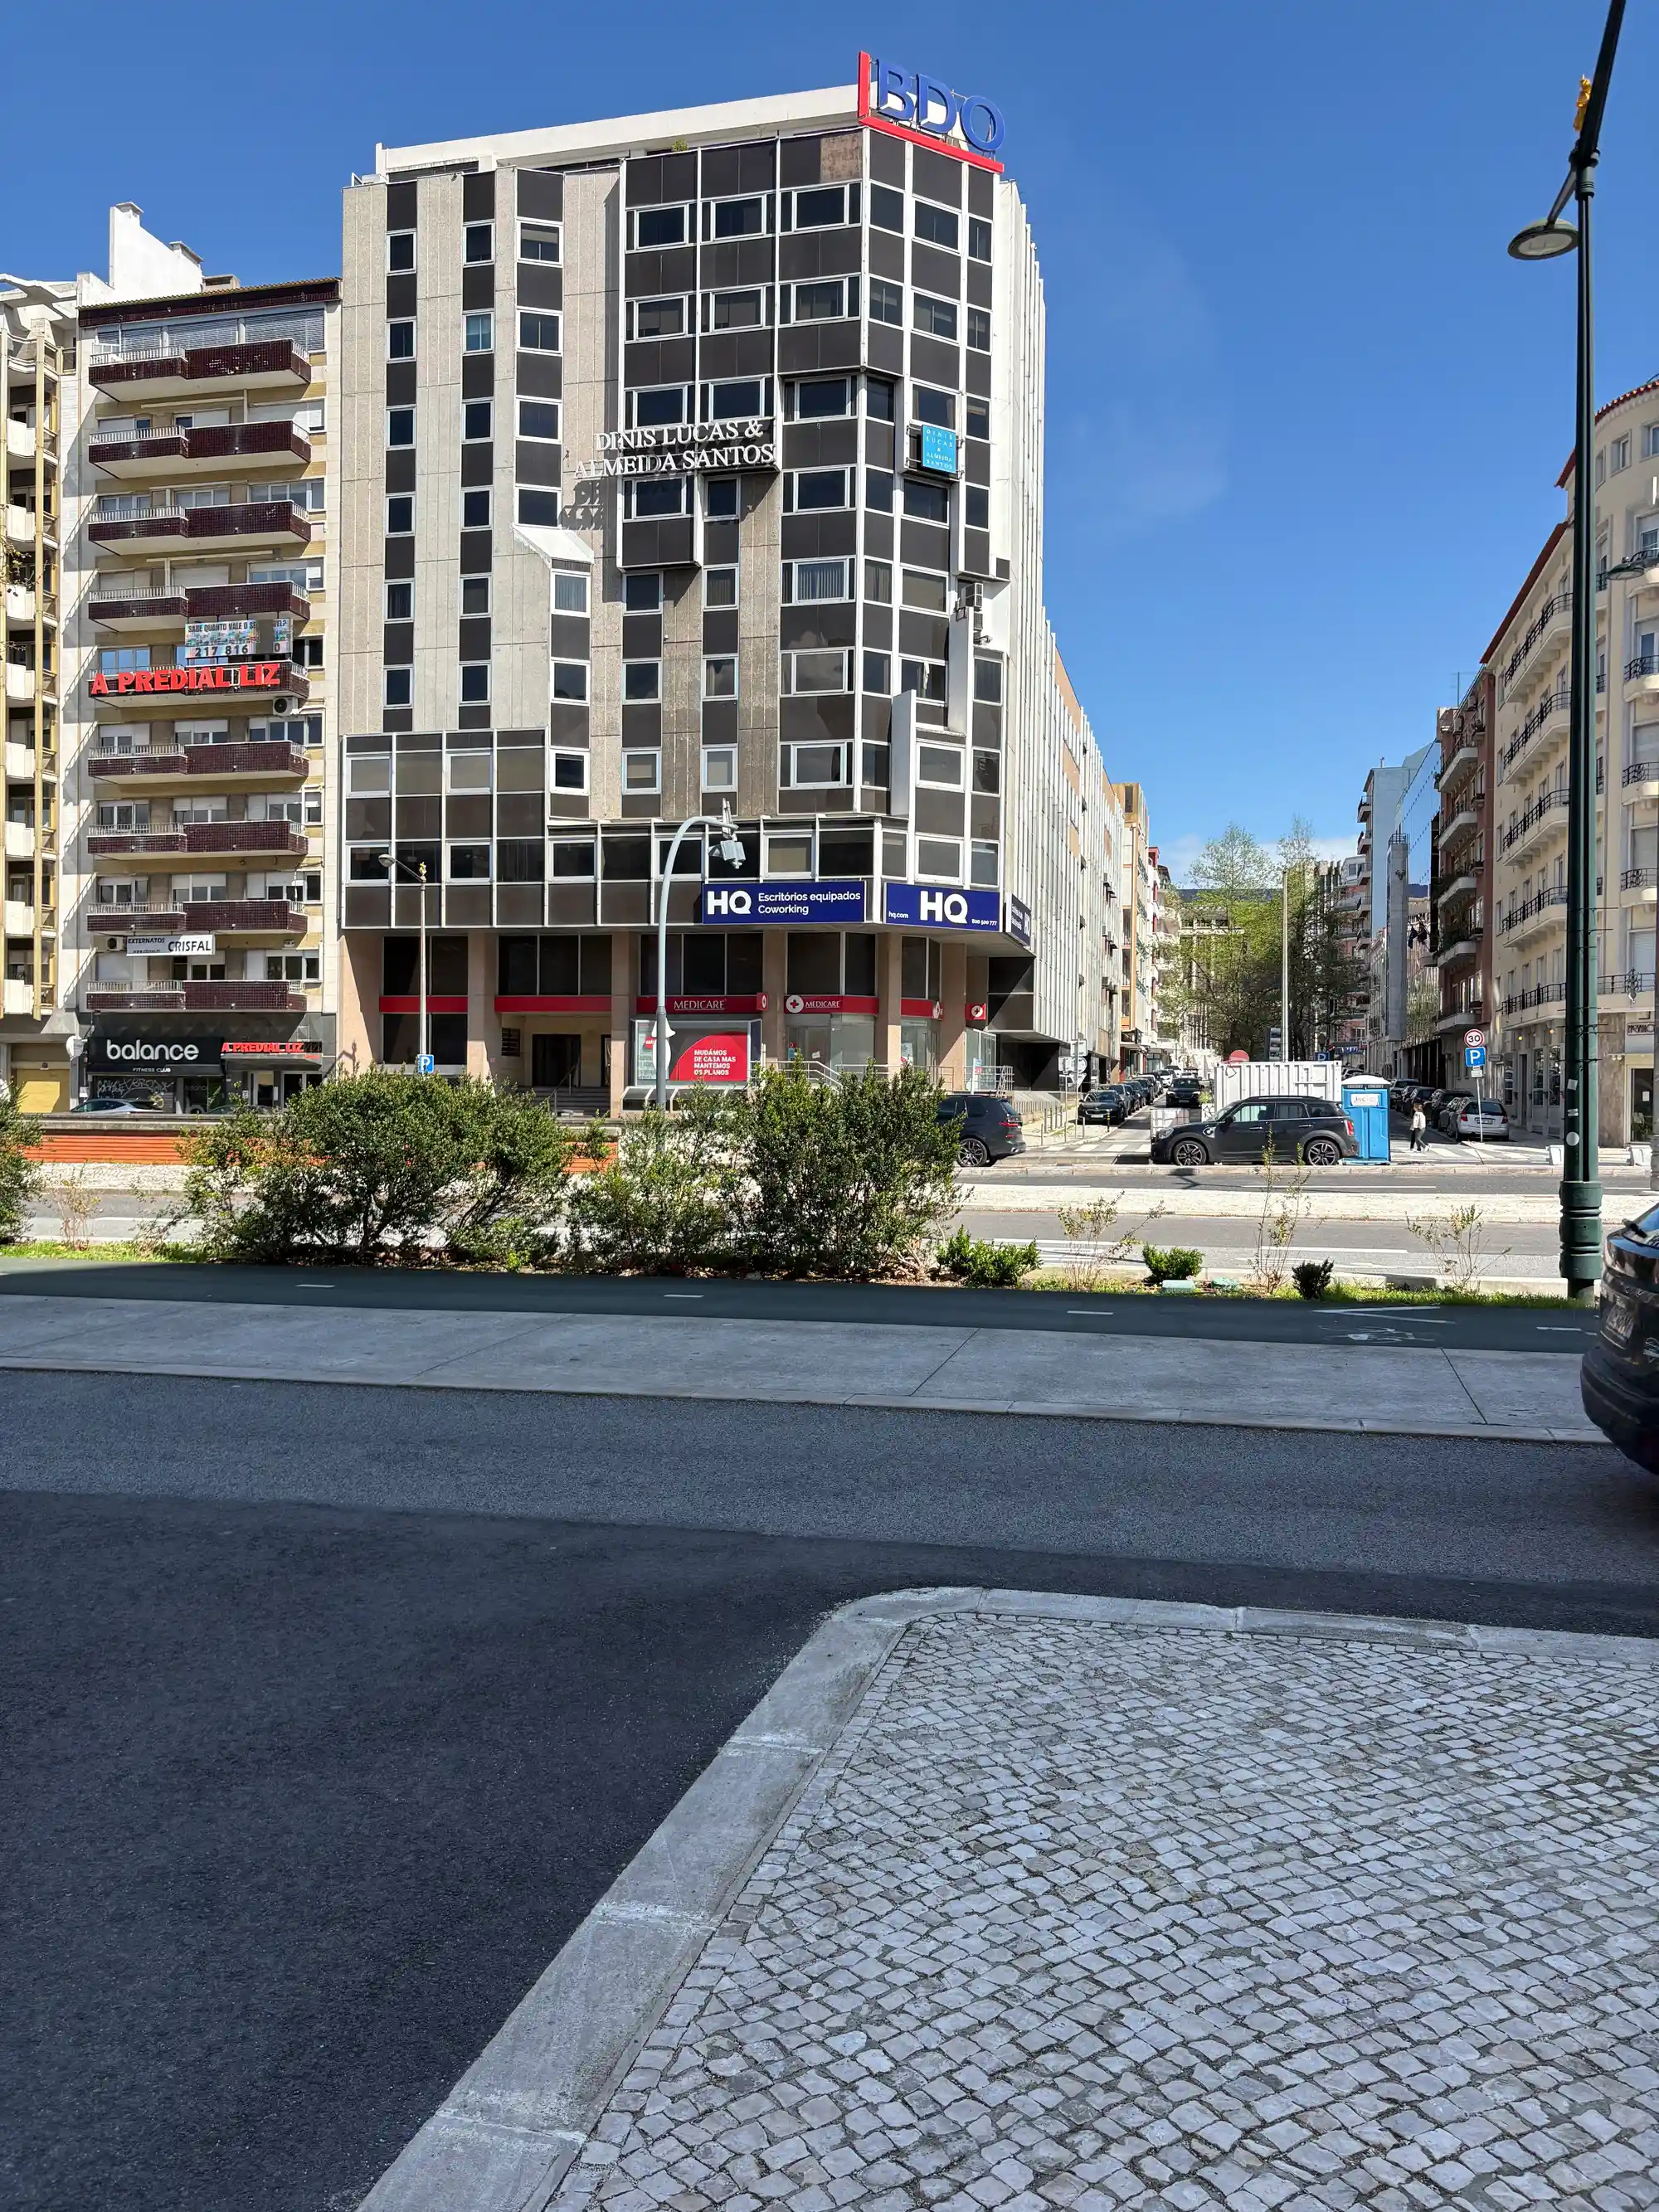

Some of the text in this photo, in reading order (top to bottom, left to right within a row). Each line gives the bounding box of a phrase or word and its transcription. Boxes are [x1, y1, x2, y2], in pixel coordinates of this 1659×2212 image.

[876, 59, 1005, 152] BDO
[595, 418, 764, 452] DINIS LUCAS &
[572, 443, 776, 479] ALMEIDA SANTOS
[188, 624, 202, 633] SABE
[204, 622, 227, 633] QUANTO
[228, 621, 242, 630] VALE
[195, 647, 218, 657] 217
[225, 644, 249, 655] 816
[91, 663, 280, 695] A PREDIAL LIZ
[708, 890, 861, 915] HQ Escritórios equipados
[758, 903, 810, 916] Coworking
[920, 890, 969, 924] HQ
[888, 911, 909, 919] hq.com
[168, 941, 212, 952] CRISFAL
[674, 999, 725, 1010] MEDICARE
[805, 1000, 840, 1009] MEDICARE
[1468, 1034, 1481, 1043] 30
[106, 1038, 200, 1061] balance
[221, 1042, 304, 1053] A PREDIAL LIZ
[421, 1056, 431, 1071] P
[1469, 1049, 1481, 1064] P
